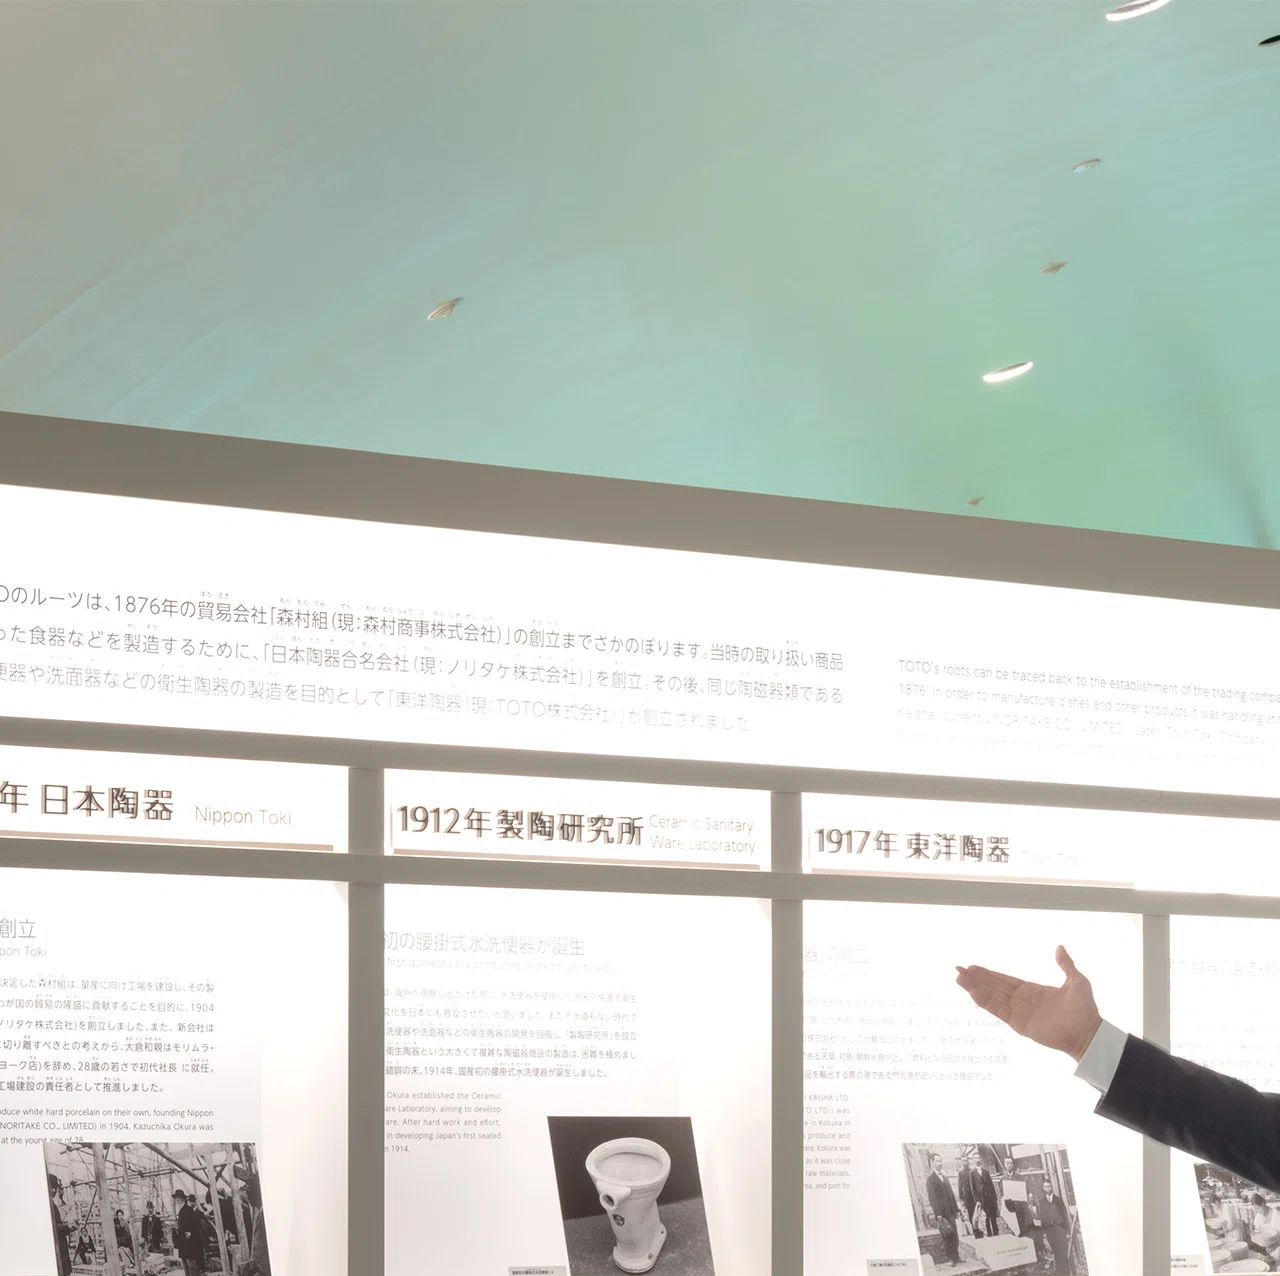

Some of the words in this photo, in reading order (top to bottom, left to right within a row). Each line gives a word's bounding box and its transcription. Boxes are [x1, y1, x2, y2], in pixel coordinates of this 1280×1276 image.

[41, 783, 174, 821] 日本陶器
[195, 805, 253, 827] Nippon
[258, 809, 292, 825] Toki
[645, 814, 701, 830] Ceramic
[703, 817, 755, 837] Sanitary
[648, 834, 685, 850] Ware
[689, 839, 757, 857] Laboratory
[814, 828, 899, 858] 1917年
[905, 831, 1010, 863] 東洋陶器
[23, 944, 49, 959] Toki
[386, 1090, 410, 1102] Okura
[411, 1091, 455, 1101] established
[454, 1091, 470, 1100] the
[470, 1091, 501, 1101] Ceramic
[0, 1121, 41, 1133] NORITAKE
[40, 1121, 61, 1131] CO.,
[62, 1121, 98, 1132] LIMITED)
[99, 1121, 107, 1131] in
[109, 1121, 131, 1131] 1904.
[132, 1122, 172, 1131] Kazuchika
[172, 1122, 197, 1131] Okura
[198, 1123, 214, 1131] was
